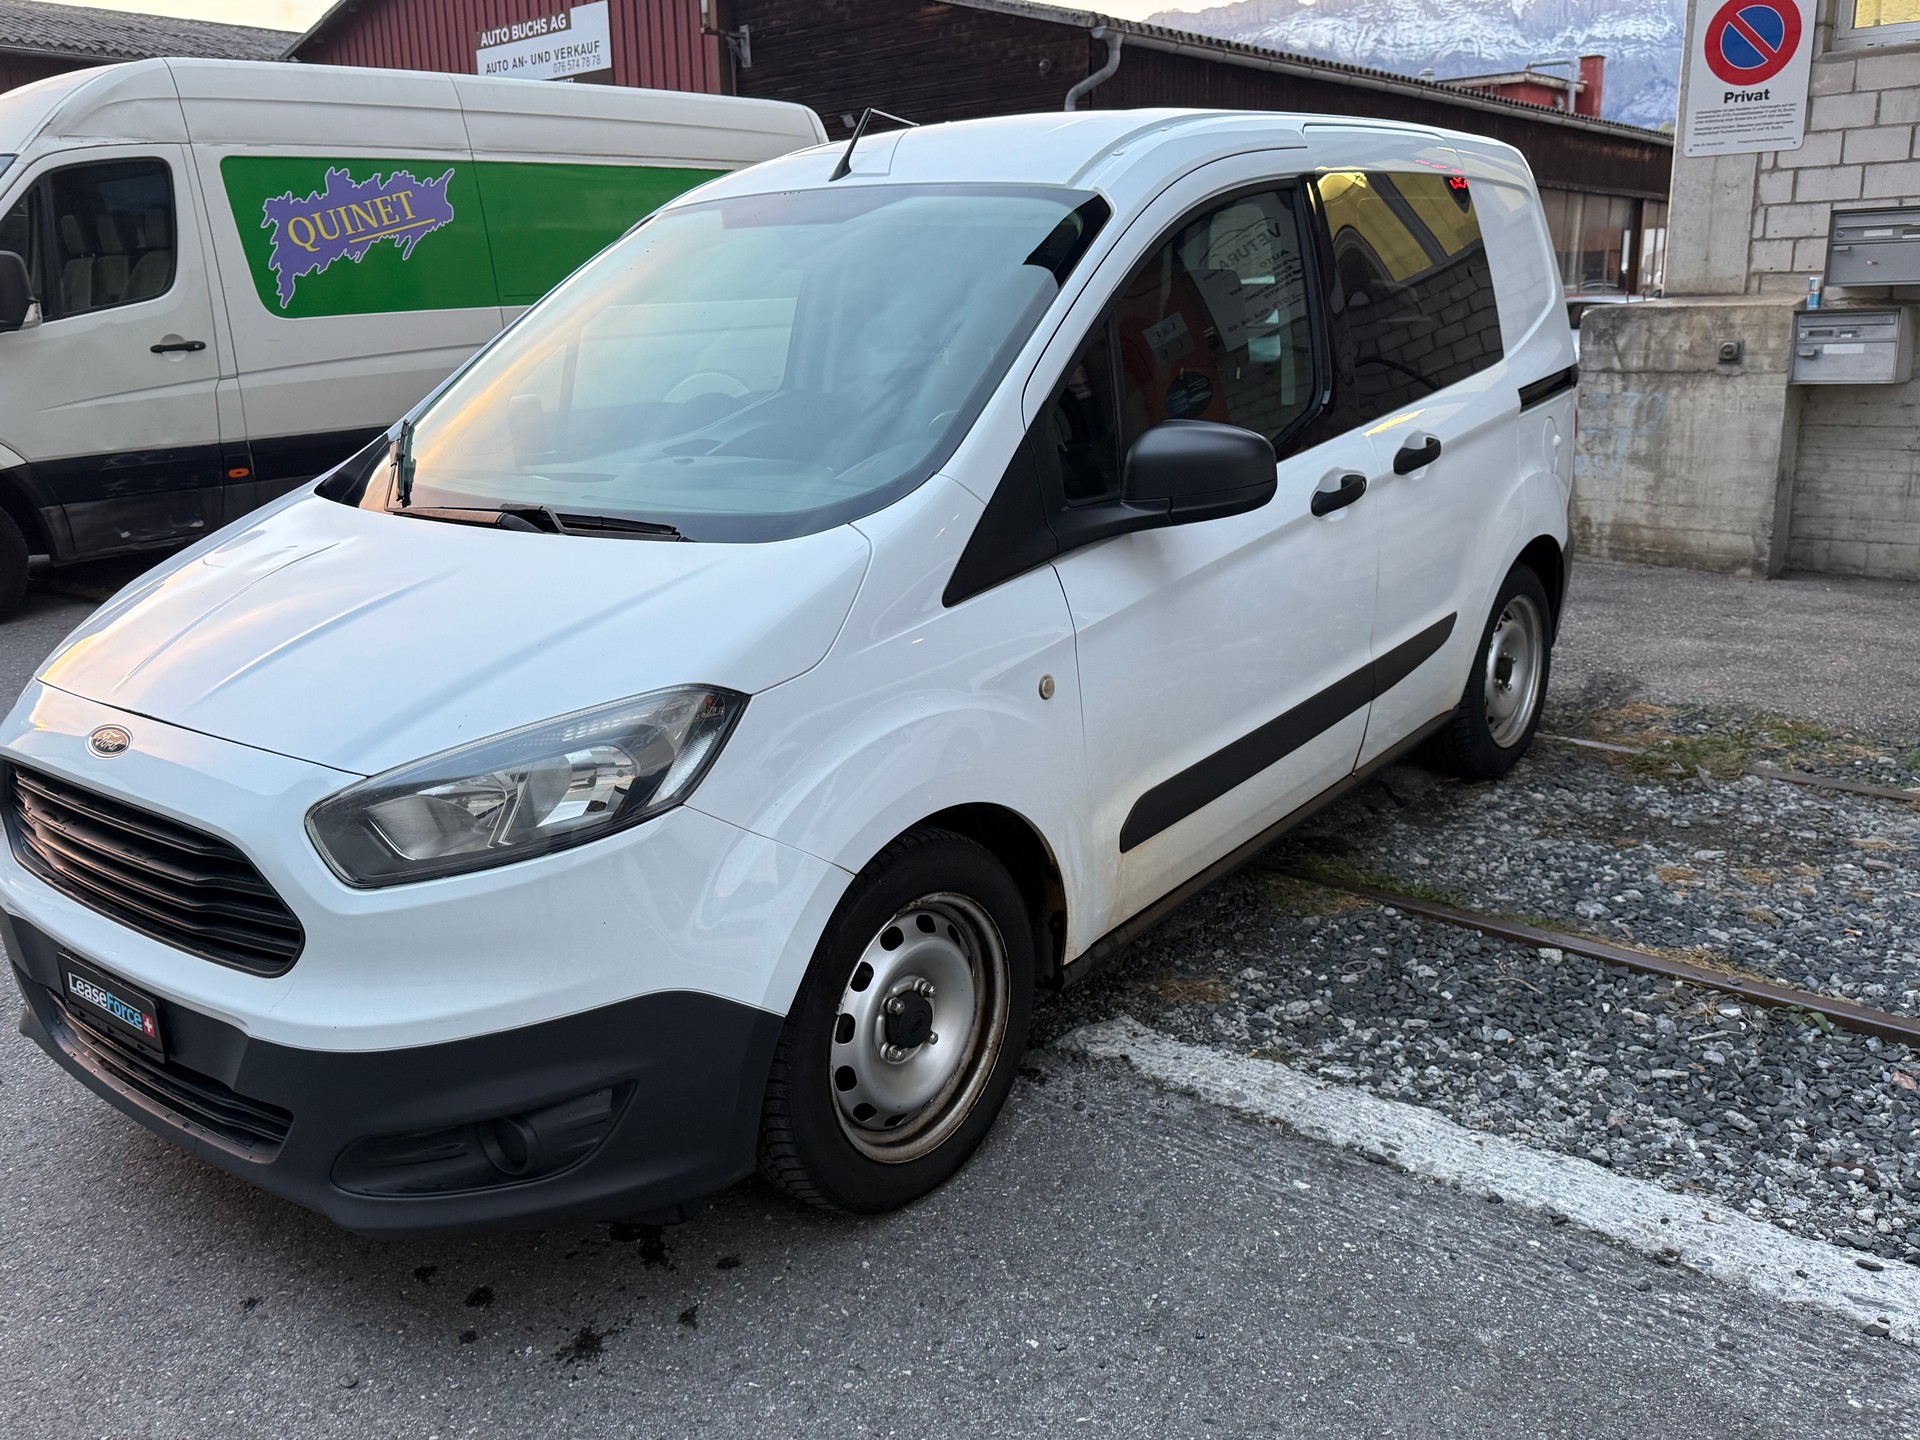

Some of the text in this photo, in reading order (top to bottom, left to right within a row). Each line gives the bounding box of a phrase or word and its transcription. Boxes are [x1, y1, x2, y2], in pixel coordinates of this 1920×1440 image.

[481, 13, 567, 47] AUTO BUCHS AG
[486, 40, 600, 75] AUTO AN- UND VERKAUF
[553, 55, 601, 73] 076 574 78 78
[1723, 89, 1770, 104] Privat
[287, 190, 417, 252] QUINET
[94, 730, 123, 752] Ford
[68, 972, 143, 1028] LeaseForce
